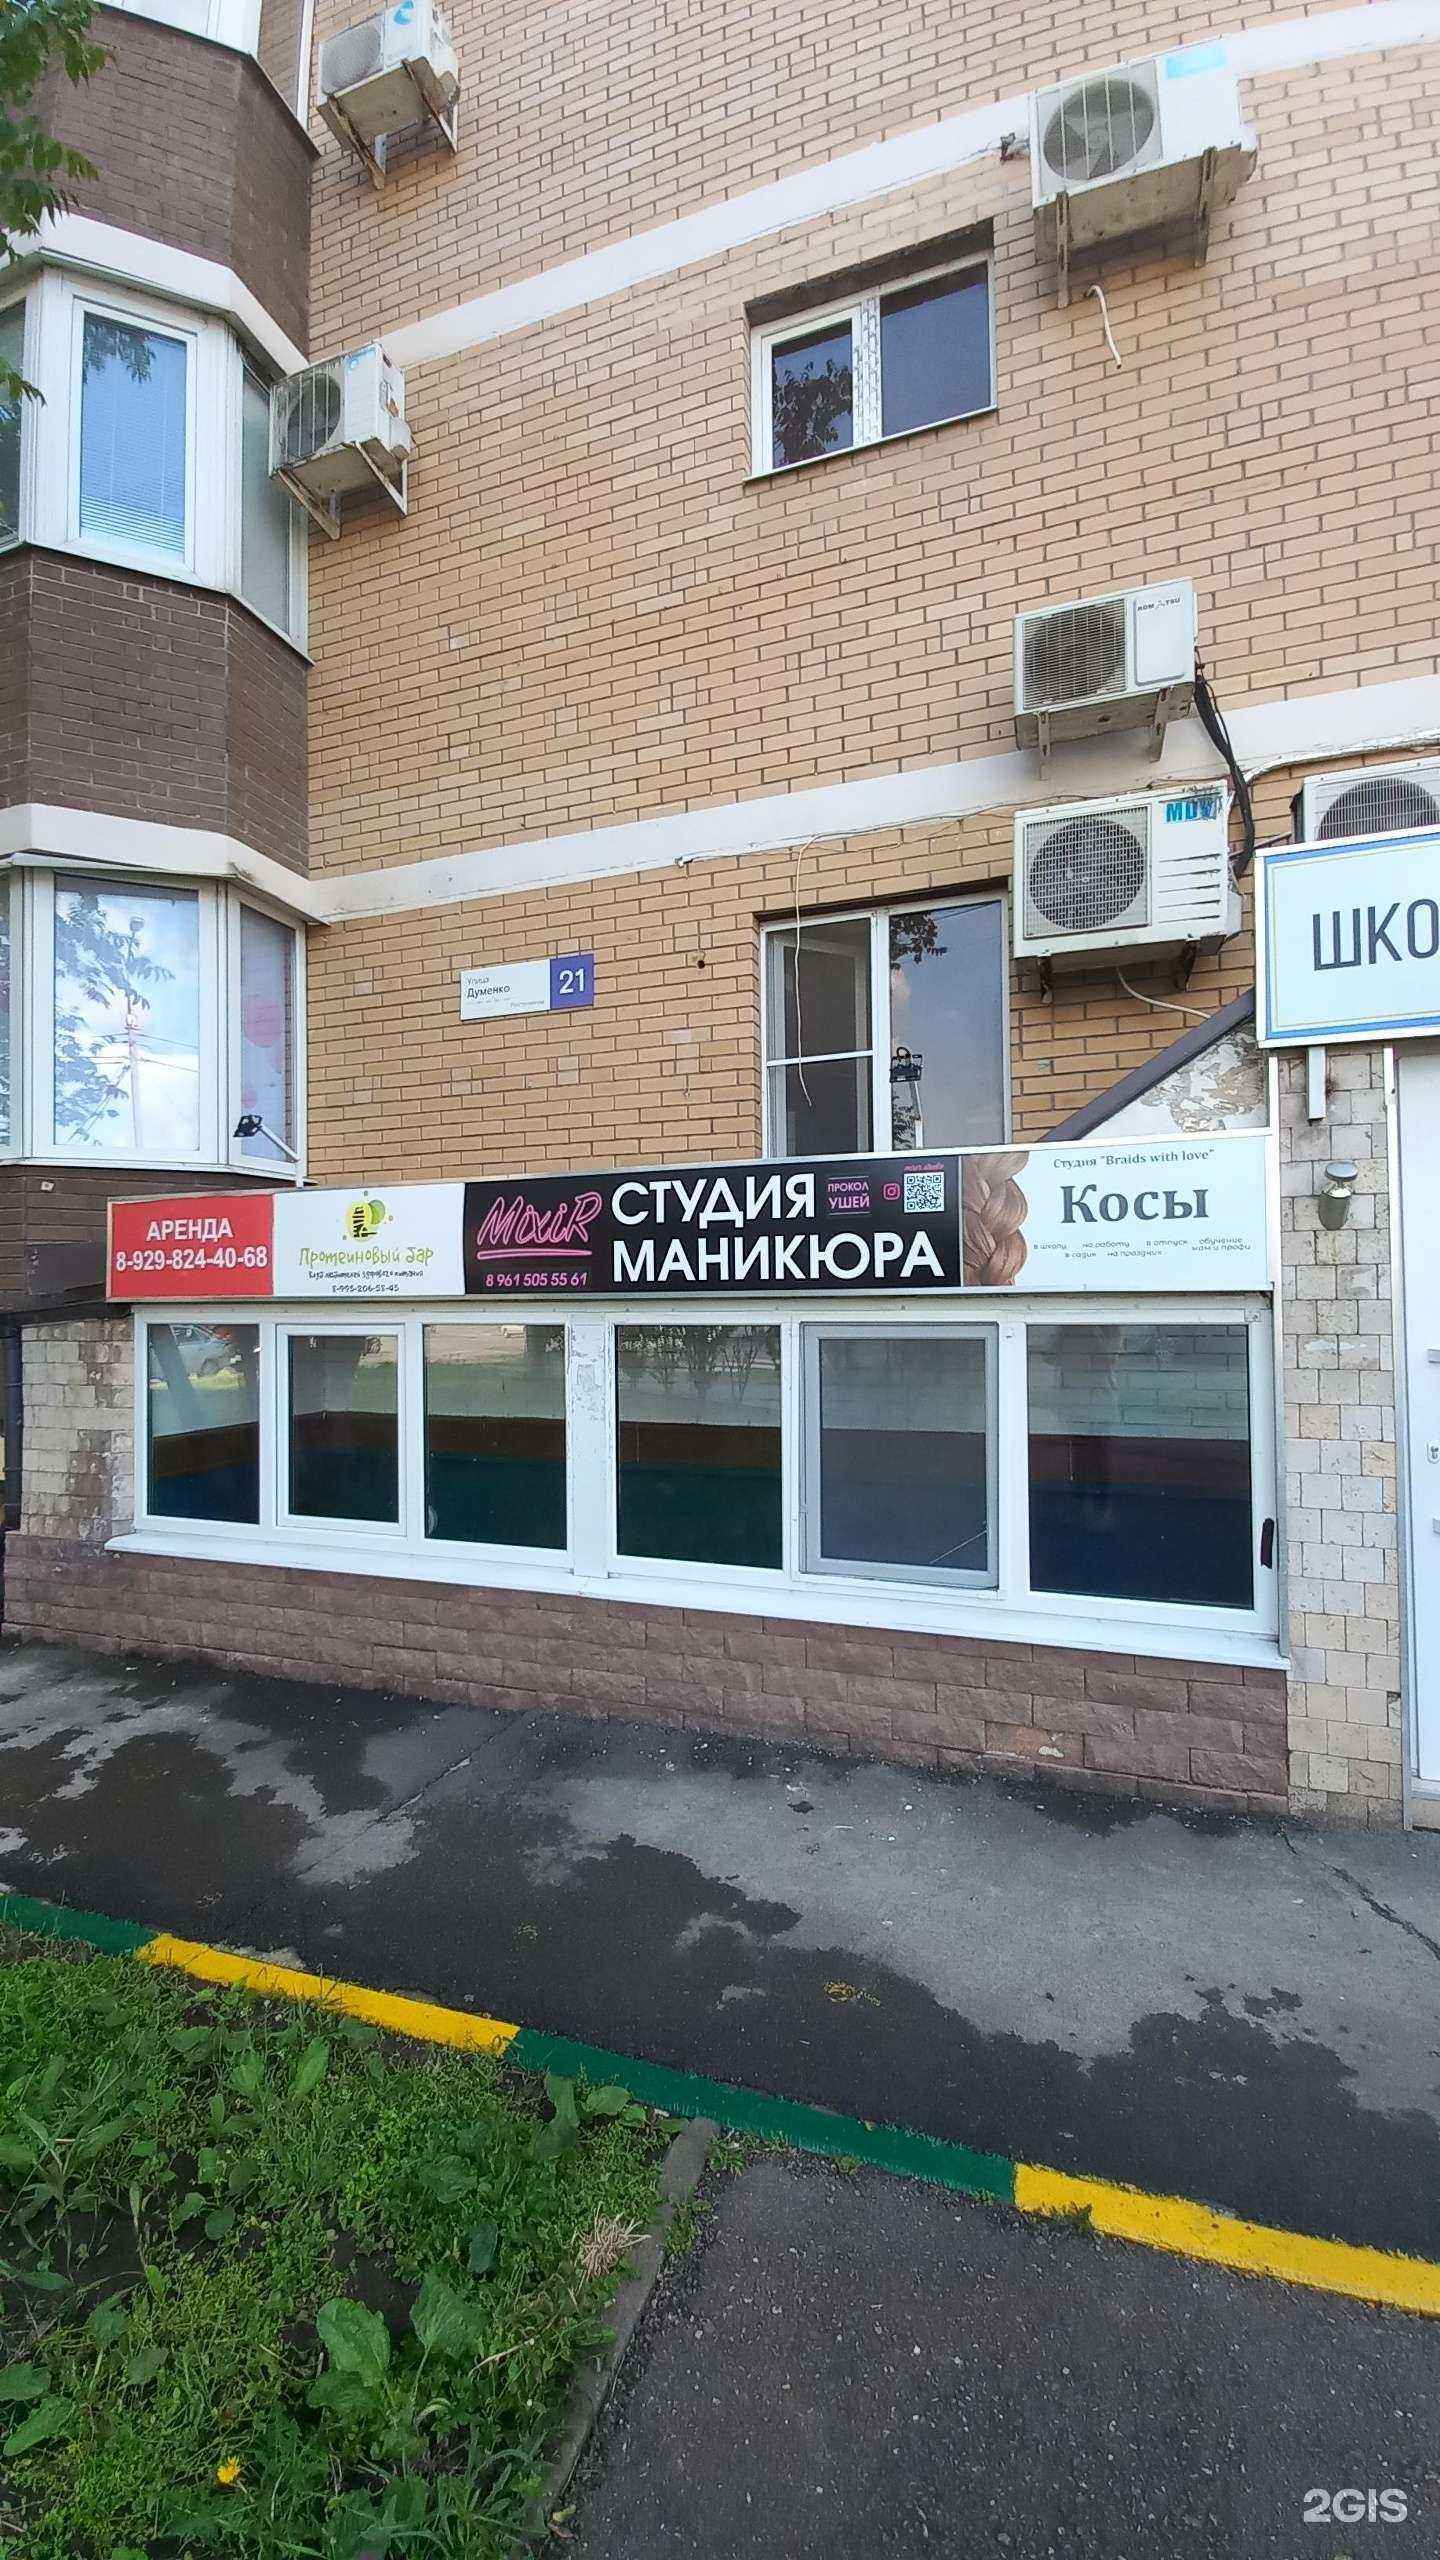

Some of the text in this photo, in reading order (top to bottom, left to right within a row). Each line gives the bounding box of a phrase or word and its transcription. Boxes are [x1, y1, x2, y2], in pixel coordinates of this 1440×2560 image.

[467, 985, 510, 999] Думенко
[559, 968, 585, 995] 21
[1150, 1151, 1179, 1163] with
[827, 1182, 869, 1192] ПРОКОЛ
[611, 1173, 815, 1229] СТУДИЯ
[828, 1193, 870, 1209] УШЕЙ
[1060, 1184, 1210, 1224] Косы
[146, 1217, 234, 1243] АРЕНДА
[116, 1245, 268, 1271] 8-929-824-40-68
[613, 1230, 945, 1283] МАНИКЮРА
[485, 1272, 587, 1287] 8 961 505 55 61
